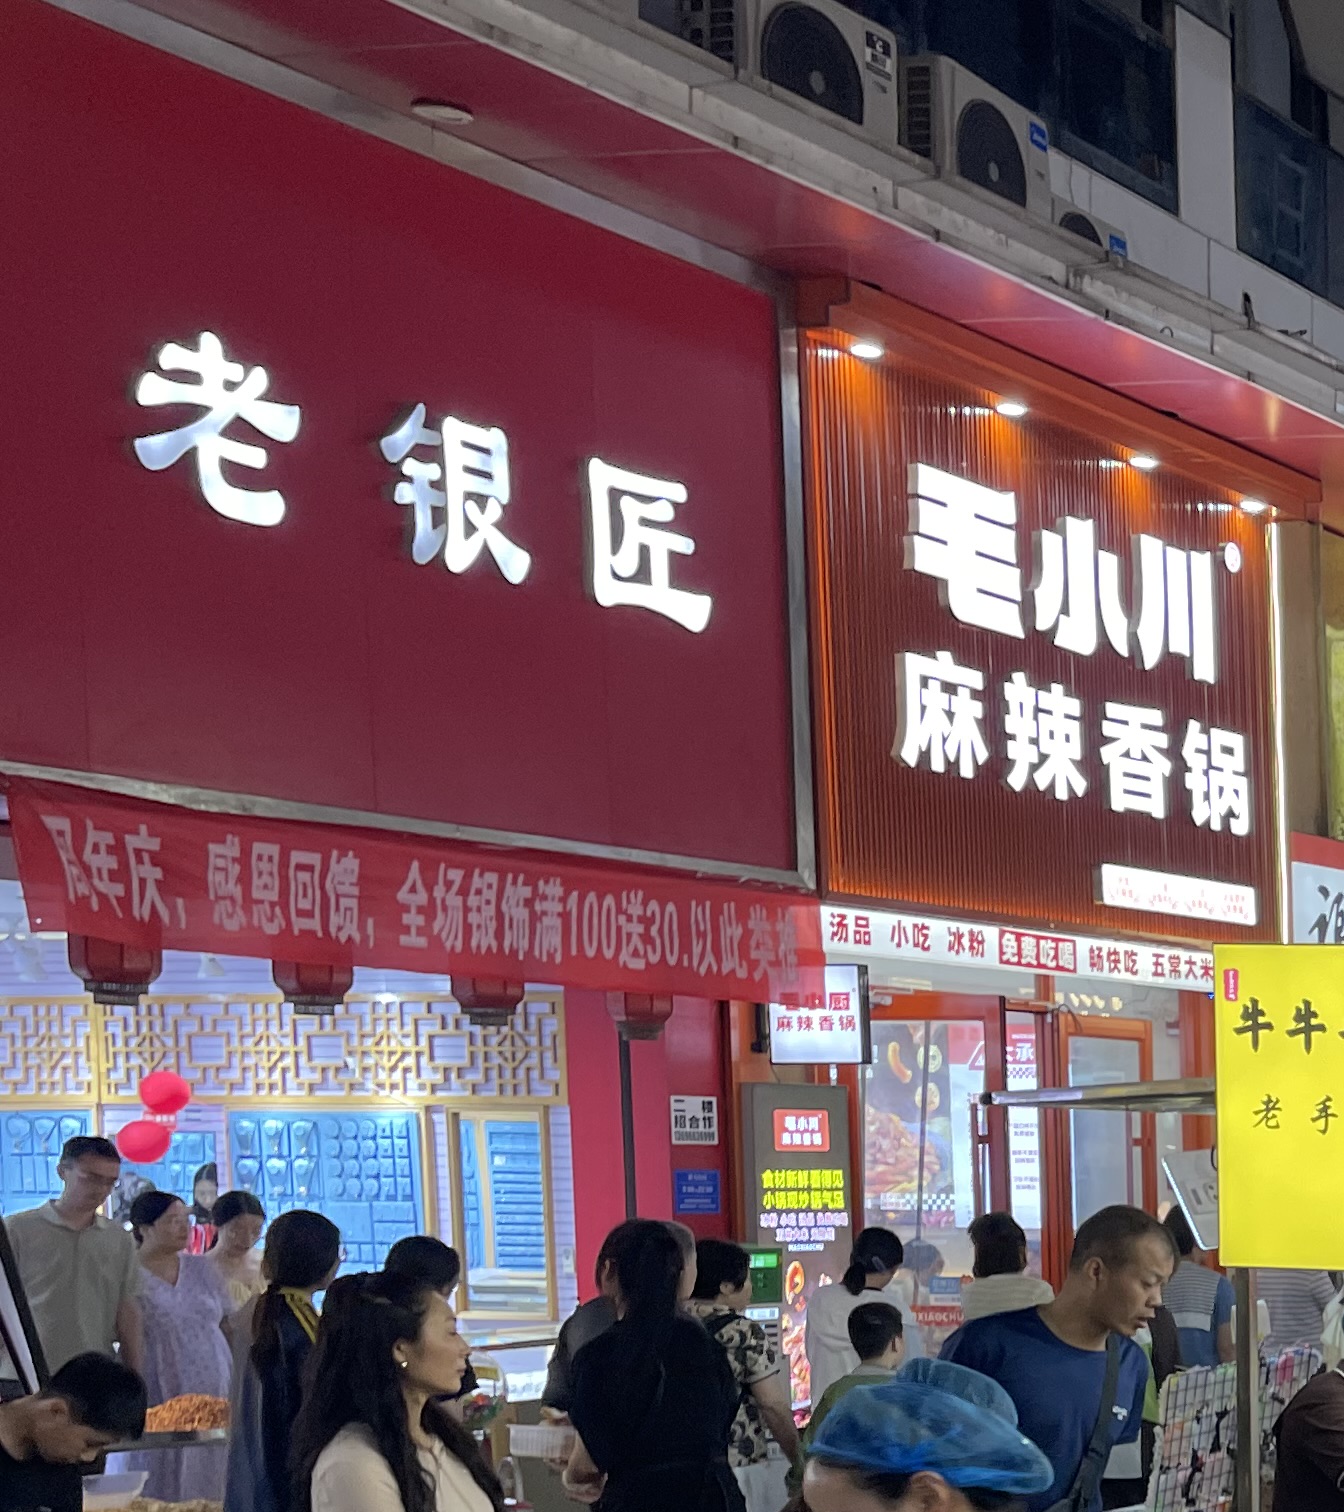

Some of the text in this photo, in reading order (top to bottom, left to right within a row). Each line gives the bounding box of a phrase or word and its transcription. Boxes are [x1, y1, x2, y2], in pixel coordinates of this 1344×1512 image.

[134, 331, 713, 633] 老银匠
[904, 463, 1217, 686] 毛小川
[893, 651, 1251, 836] 麻辣香锅
[776, 1014, 856, 1032] 麻辣香锅
[829, 913, 1214, 983] 汤品 小吃 冰粉 免费吃喝 畅快吃 五常大米
